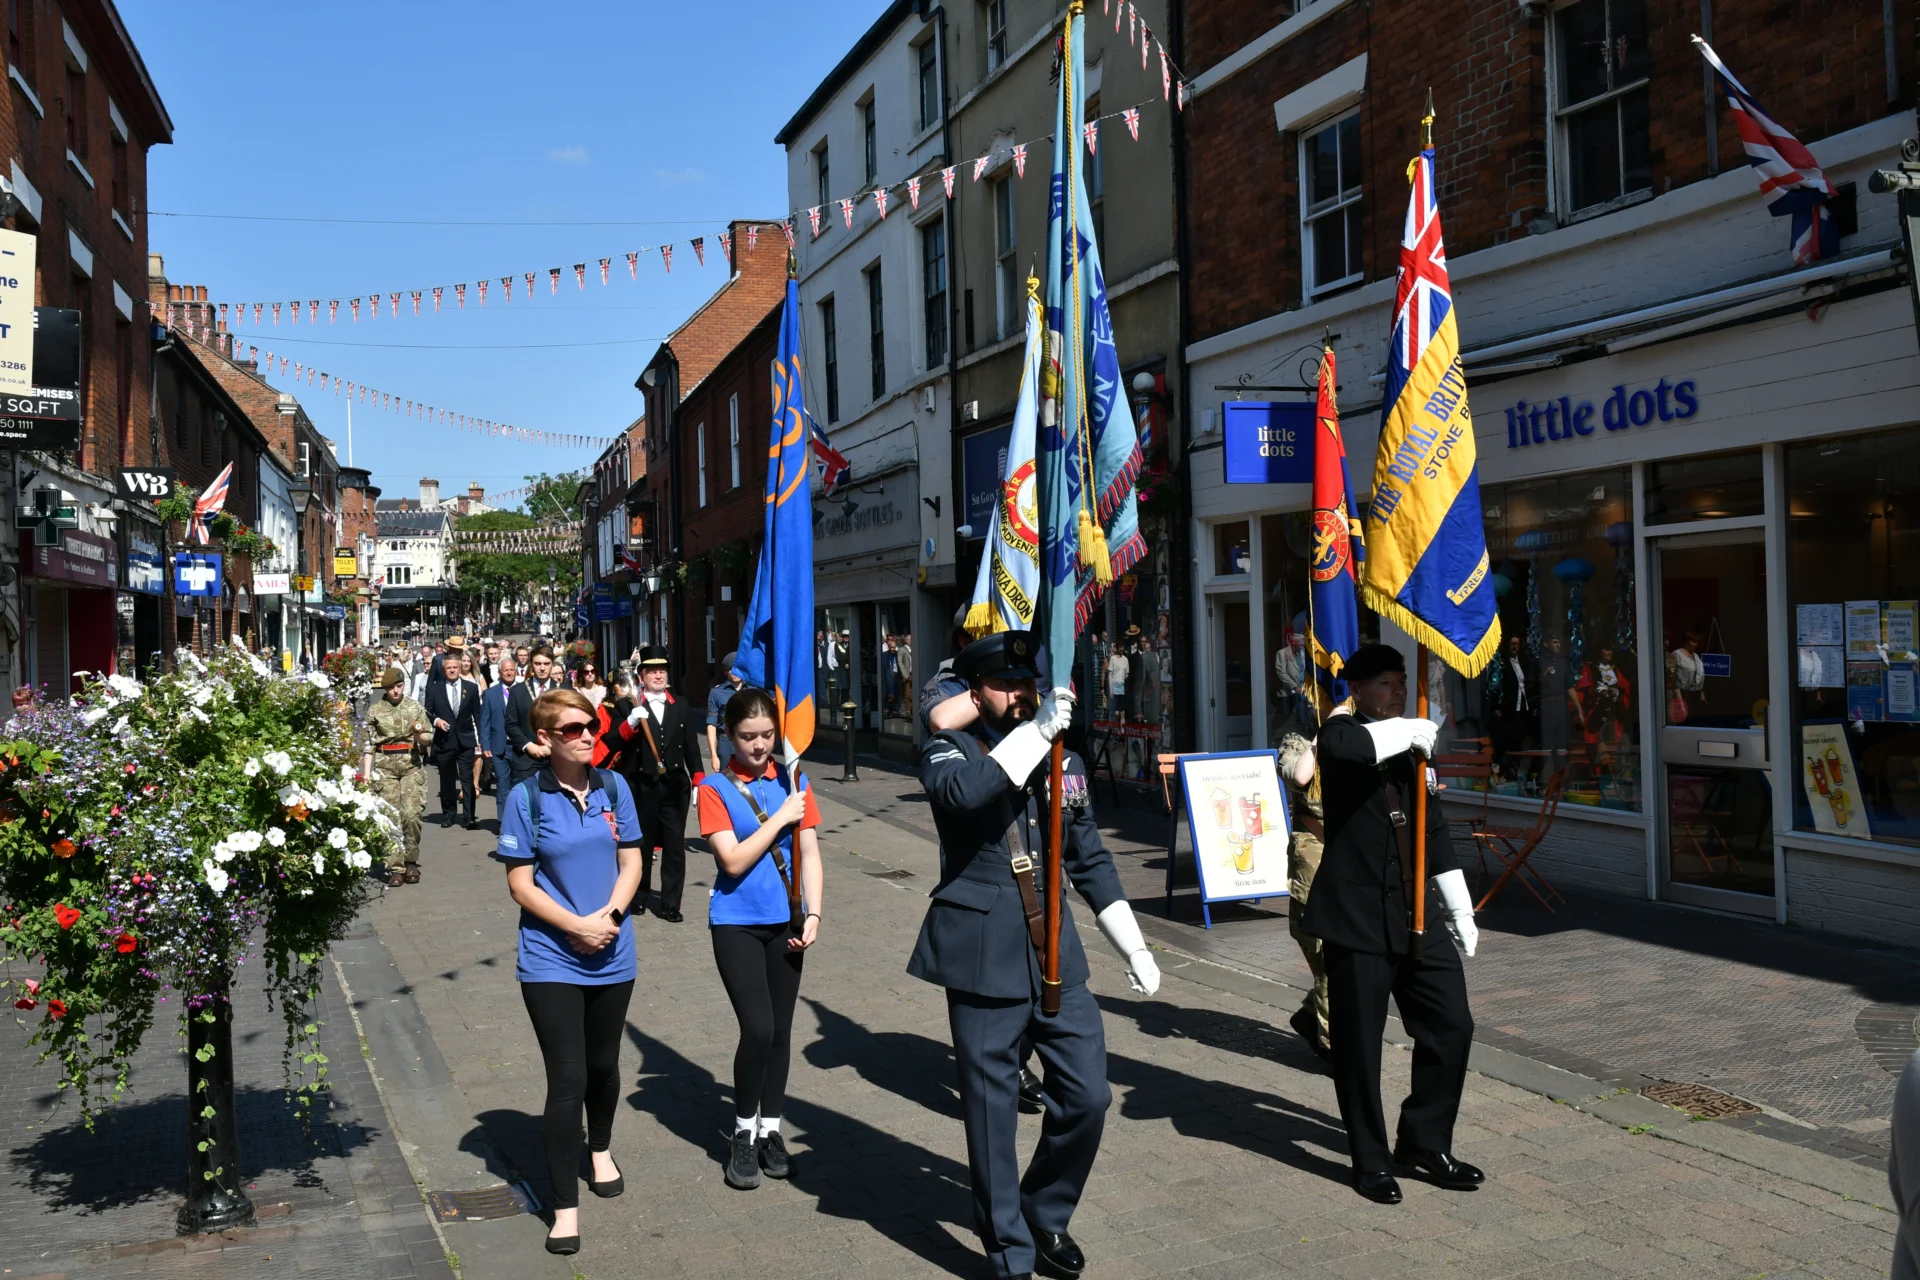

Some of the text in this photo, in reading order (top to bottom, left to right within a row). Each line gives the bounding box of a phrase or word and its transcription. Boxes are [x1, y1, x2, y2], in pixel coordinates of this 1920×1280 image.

[7, 398, 61, 415] SQ.FT
[1504, 378, 1698, 449] little dots
[1257, 425, 1296, 442] little
[1368, 353, 1466, 525] THE ROYAL BRITIS
[1259, 442, 1295, 457] dots
[1423, 424, 1464, 480] STONE
[1006, 477, 1023, 505] AIR
[256, 579, 287, 588] NAILS
[992, 557, 1033, 620] SQUADRON
[1457, 568, 1484, 599] YPRES
[1201, 773, 1228, 782] Drinks
[1235, 878, 1267, 887] little dots
